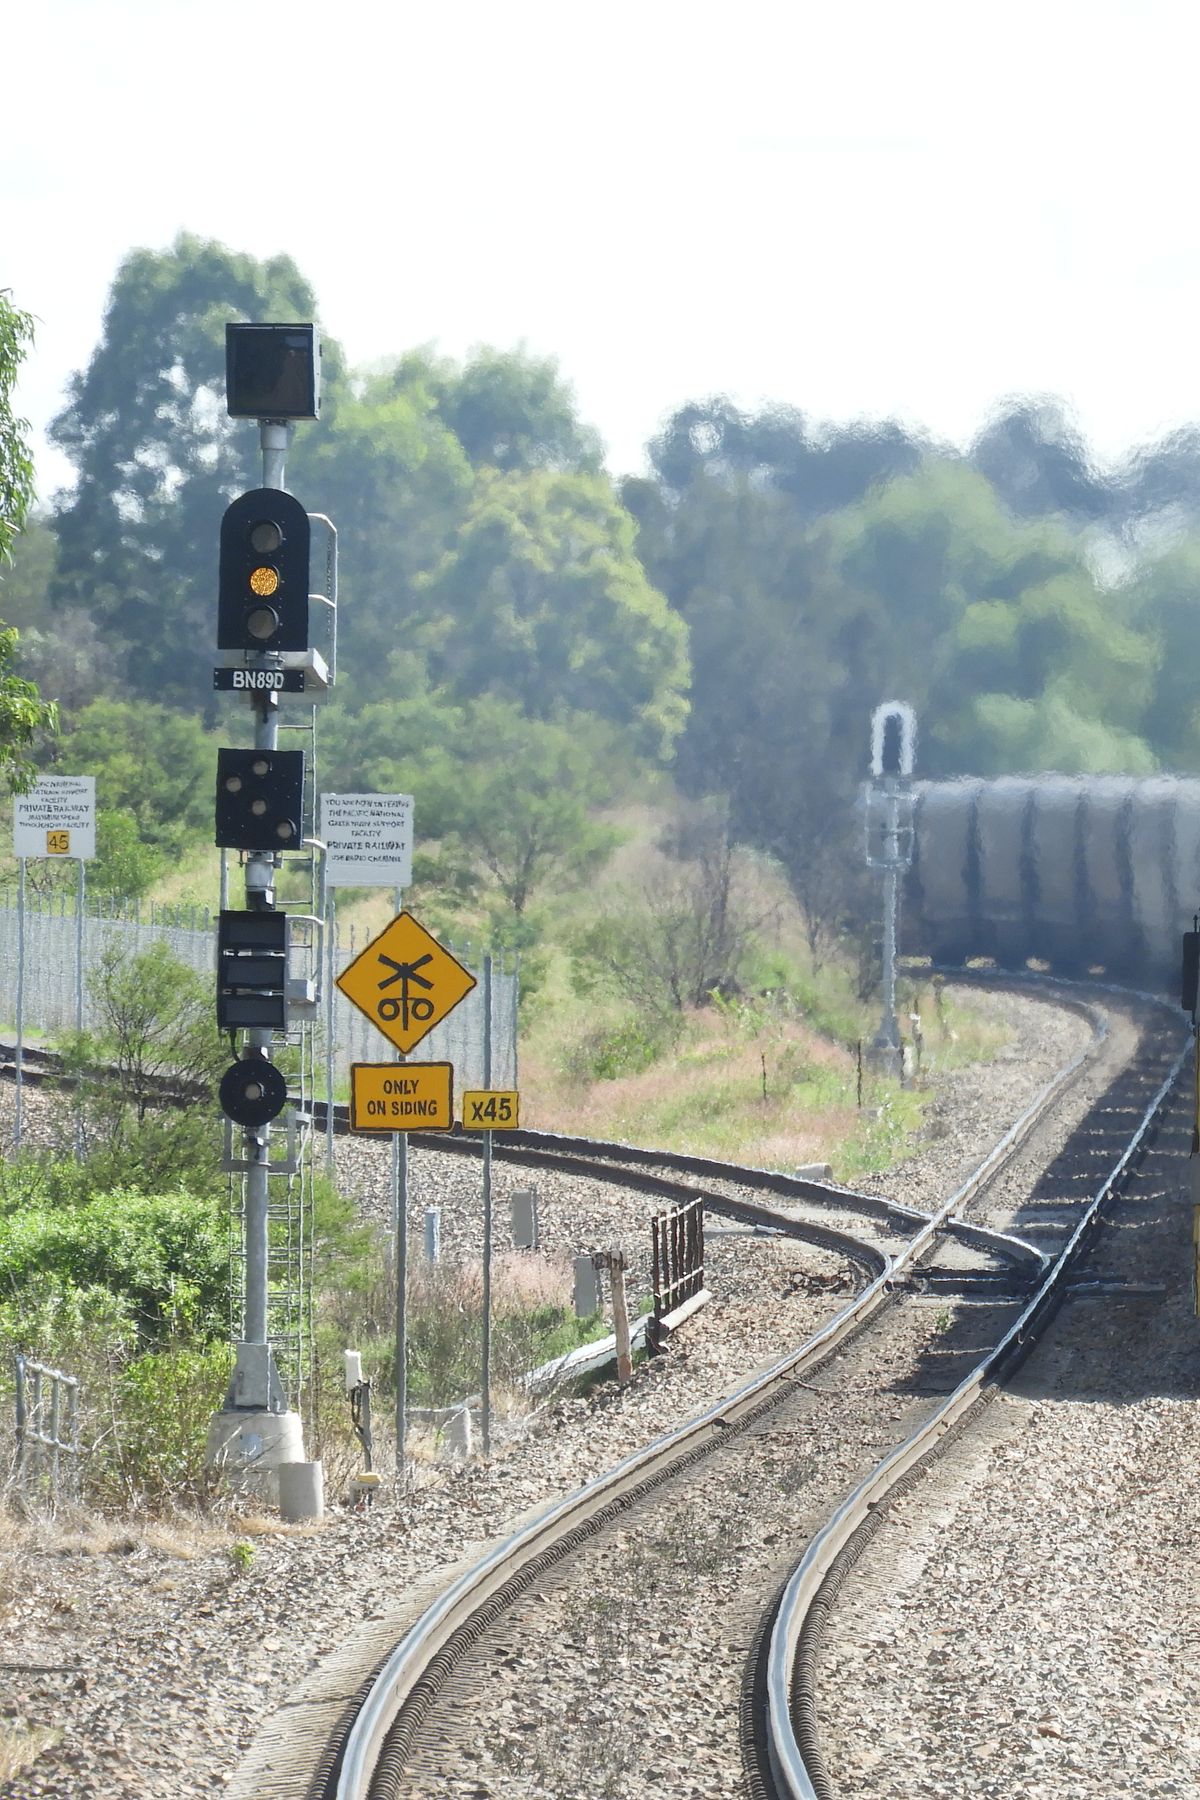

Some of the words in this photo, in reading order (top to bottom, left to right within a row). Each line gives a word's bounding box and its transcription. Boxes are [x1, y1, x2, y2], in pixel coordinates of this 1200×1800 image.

[233, 671, 284, 688] BN89D
[49, 835, 69, 850] 45
[383, 1079, 419, 1095] ONLY
[367, 1100, 386, 1116] ON
[391, 1100, 438, 1116] SIDING
[471, 1097, 512, 1122] X45
